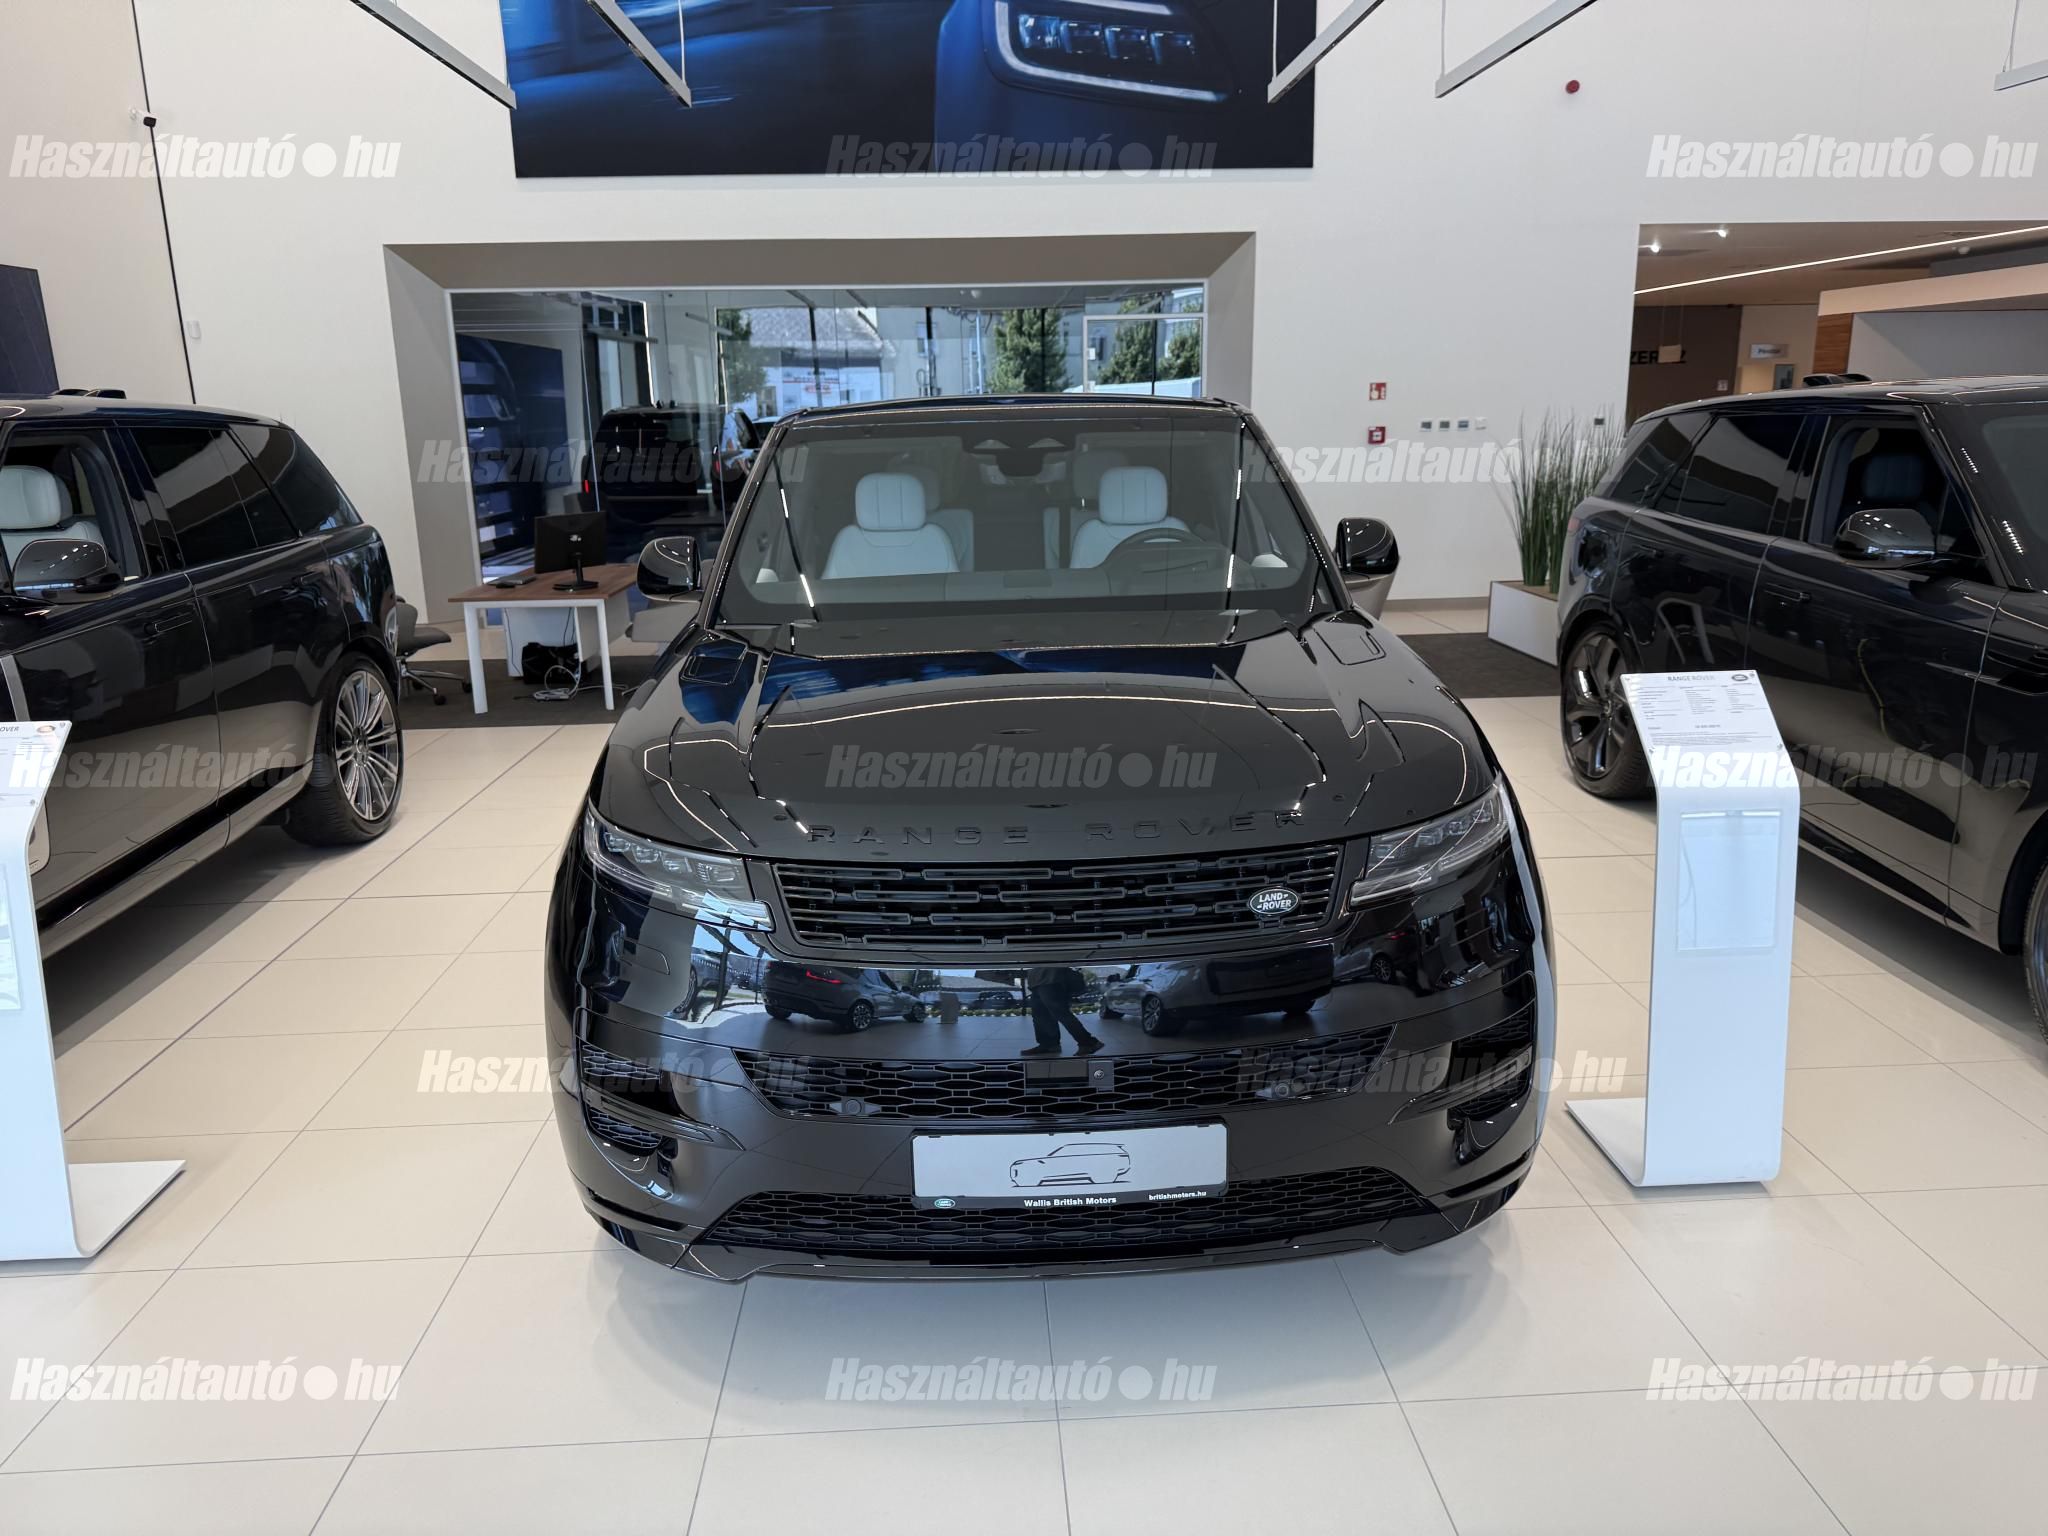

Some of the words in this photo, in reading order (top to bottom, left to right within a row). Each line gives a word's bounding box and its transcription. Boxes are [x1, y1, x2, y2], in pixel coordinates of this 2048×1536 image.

[807, 824, 1030, 845] RANGE
[1085, 808, 1305, 841] ROVER
[1148, 1190, 1207, 1201] britishmotors.hu
[1023, 1199, 1051, 1208] Wallis
[1053, 1197, 1083, 1206] British
[1085, 1196, 1117, 1205] Motors
